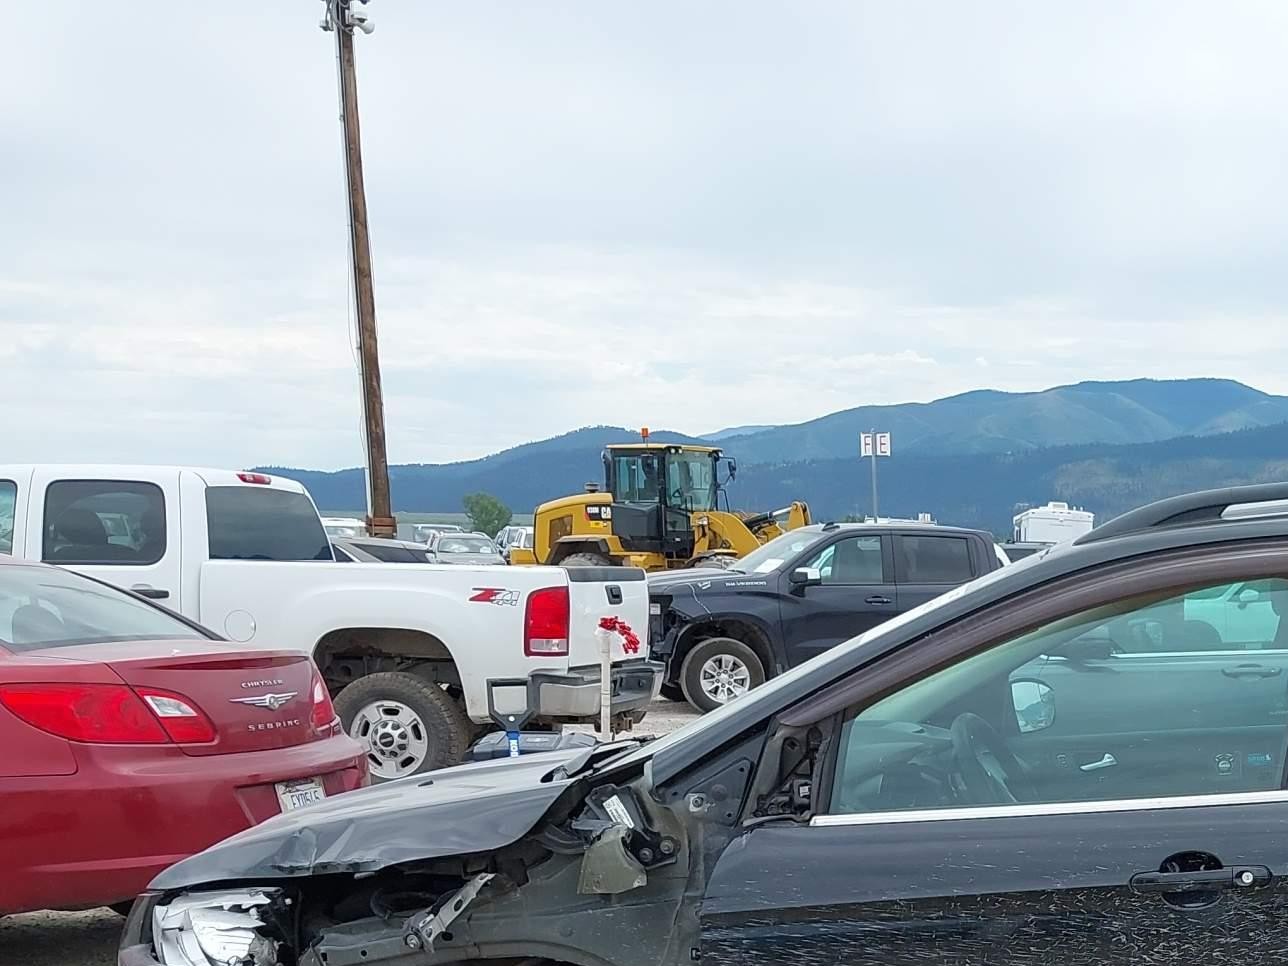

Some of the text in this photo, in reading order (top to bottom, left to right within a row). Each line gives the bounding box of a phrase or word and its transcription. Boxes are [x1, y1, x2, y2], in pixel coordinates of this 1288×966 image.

[864, 435, 871, 454] F
[879, 435, 887, 453] E
[601, 506, 612, 519] CA
[241, 680, 284, 688] CHRYSLER
[248, 719, 300, 731] SEBRING
